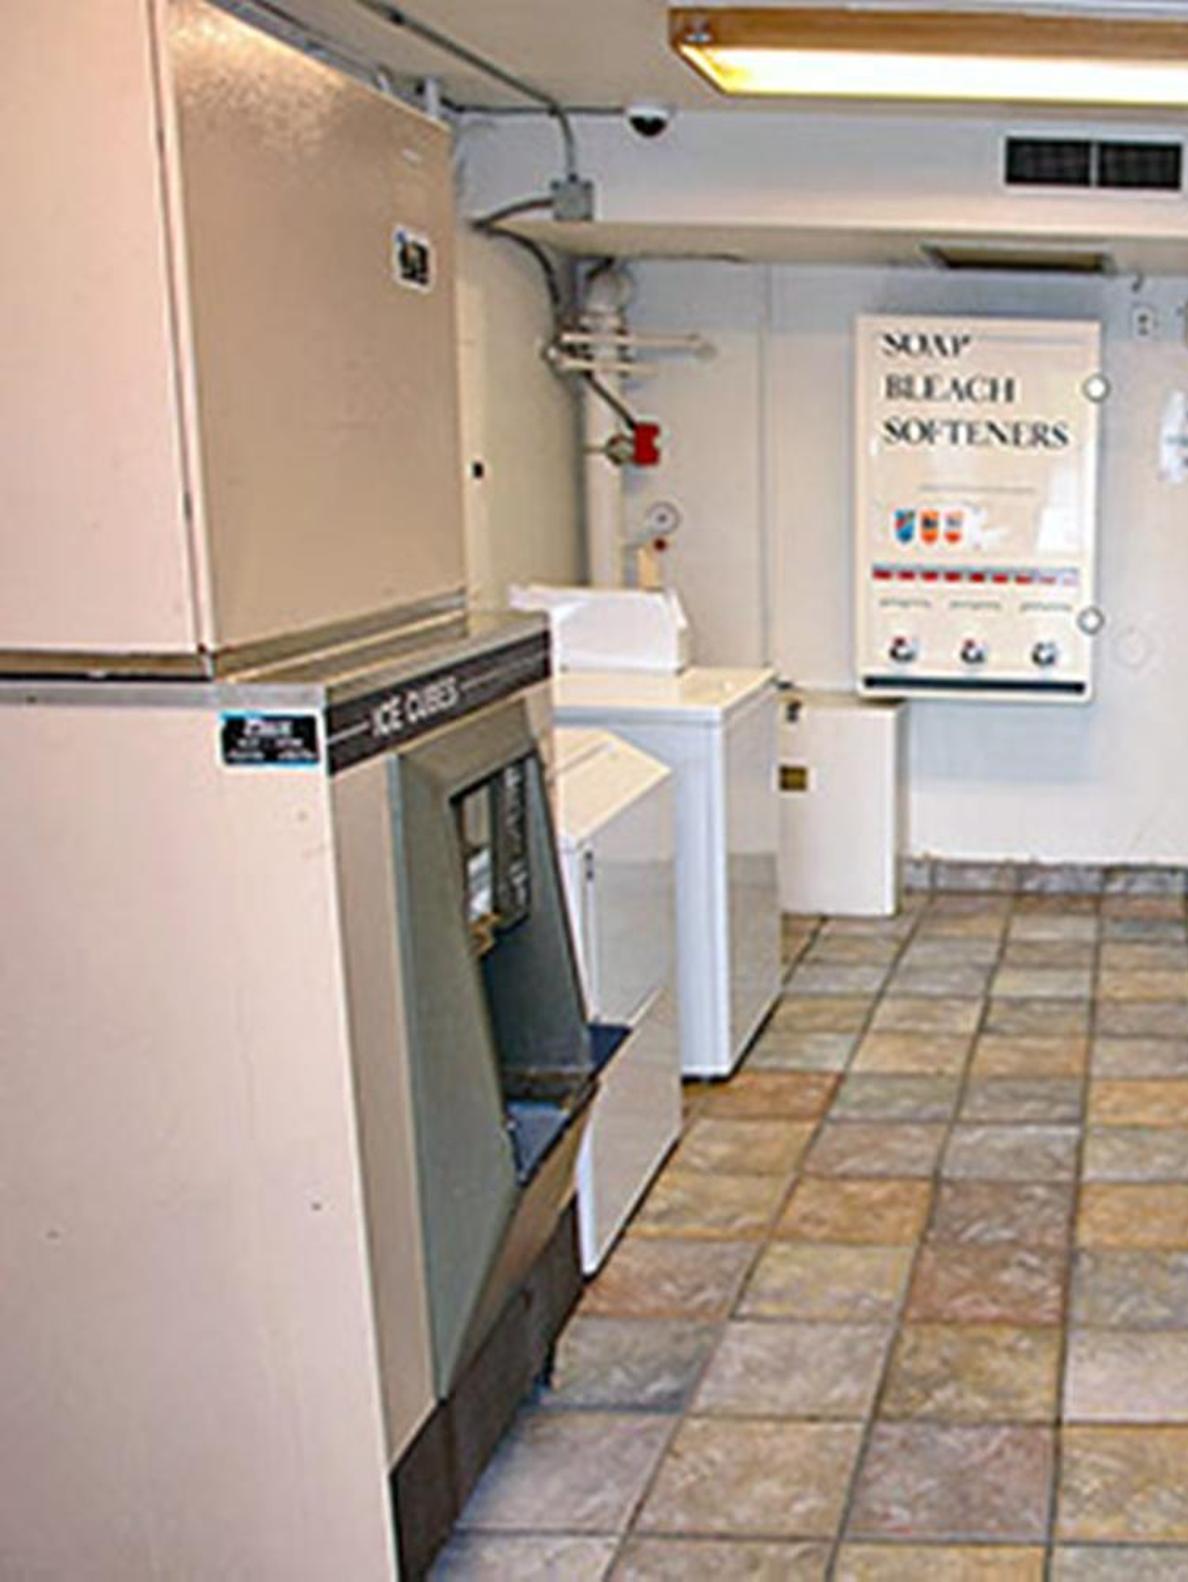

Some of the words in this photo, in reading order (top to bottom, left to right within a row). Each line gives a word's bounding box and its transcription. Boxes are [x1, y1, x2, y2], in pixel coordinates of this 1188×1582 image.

[883, 333, 971, 357] SOAP
[885, 373, 1015, 402] BLEACH
[883, 417, 1069, 448] SOFTENERS
[371, 696, 403, 738] ICE
